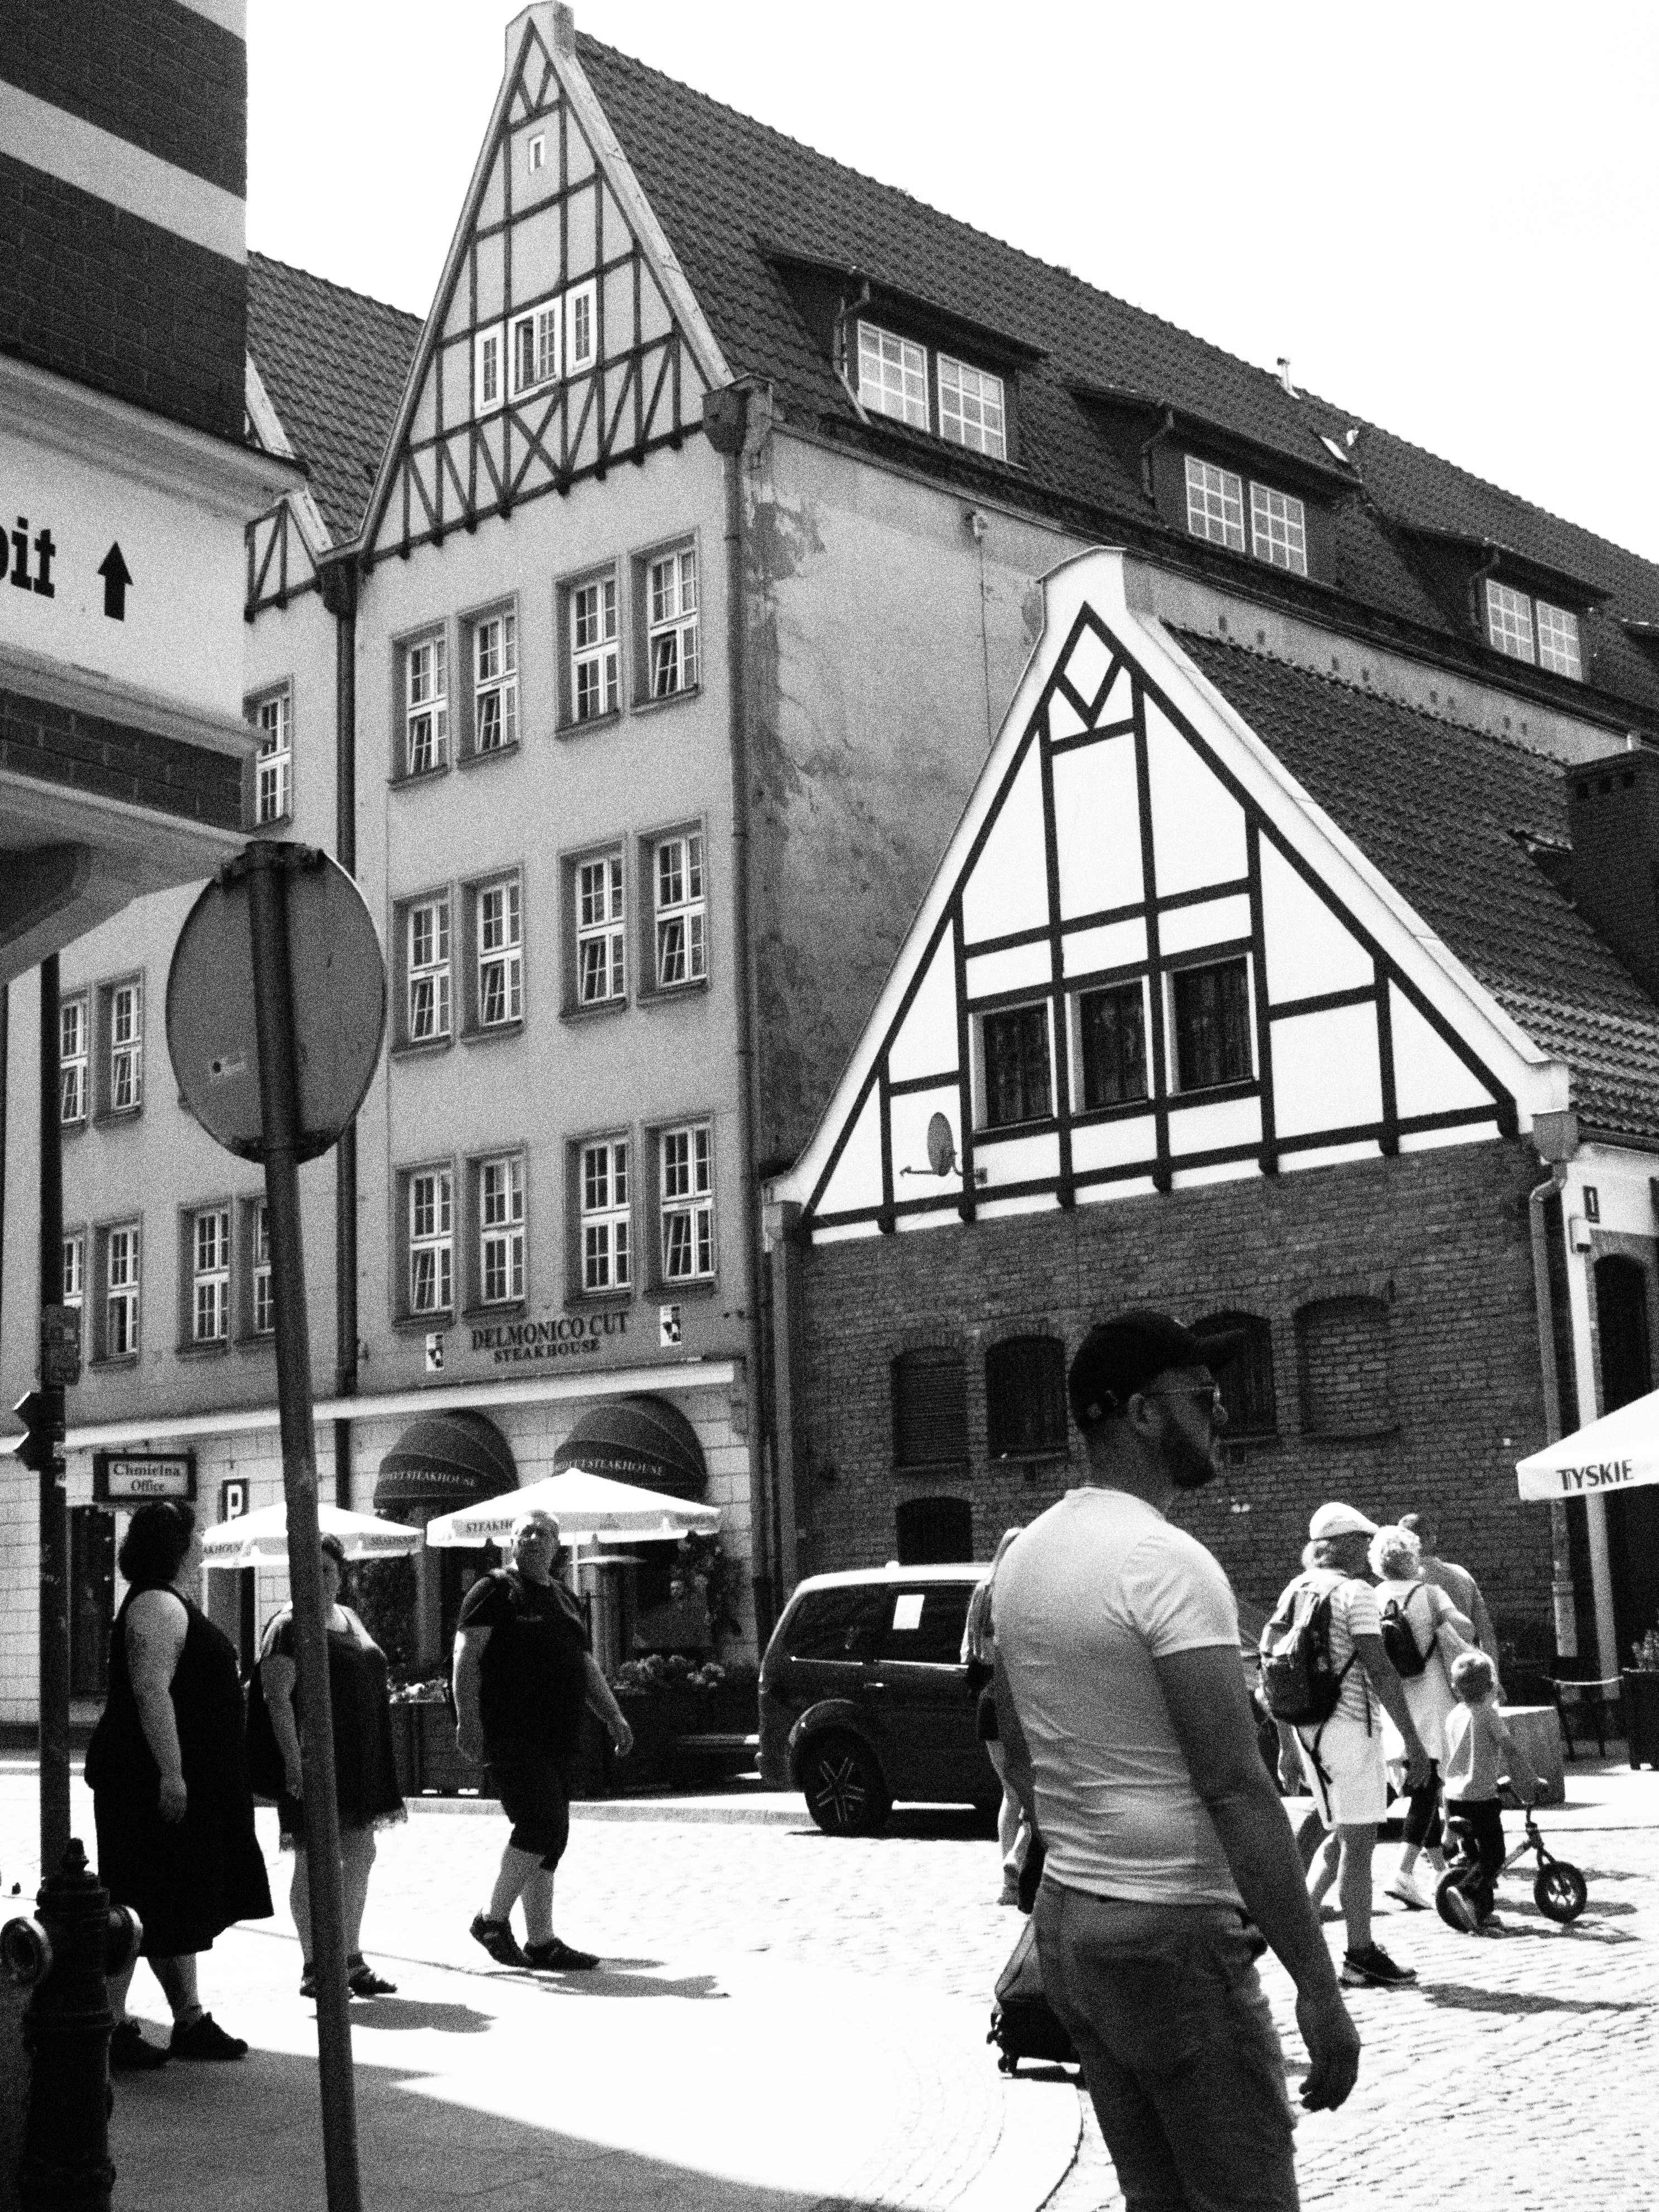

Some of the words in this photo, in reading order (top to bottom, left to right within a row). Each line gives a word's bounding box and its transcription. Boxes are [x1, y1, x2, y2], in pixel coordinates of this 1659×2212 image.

[472, 1317, 584, 1351] DELMONICO
[589, 1311, 629, 1336] CUT
[494, 1338, 600, 1364] STEAKHOUSE
[113, 1463, 181, 1477] Chmielna
[1556, 1459, 1634, 1491] TYSKIE
[131, 1479, 165, 1492] Office
[465, 1520, 513, 1533] STEAKH
